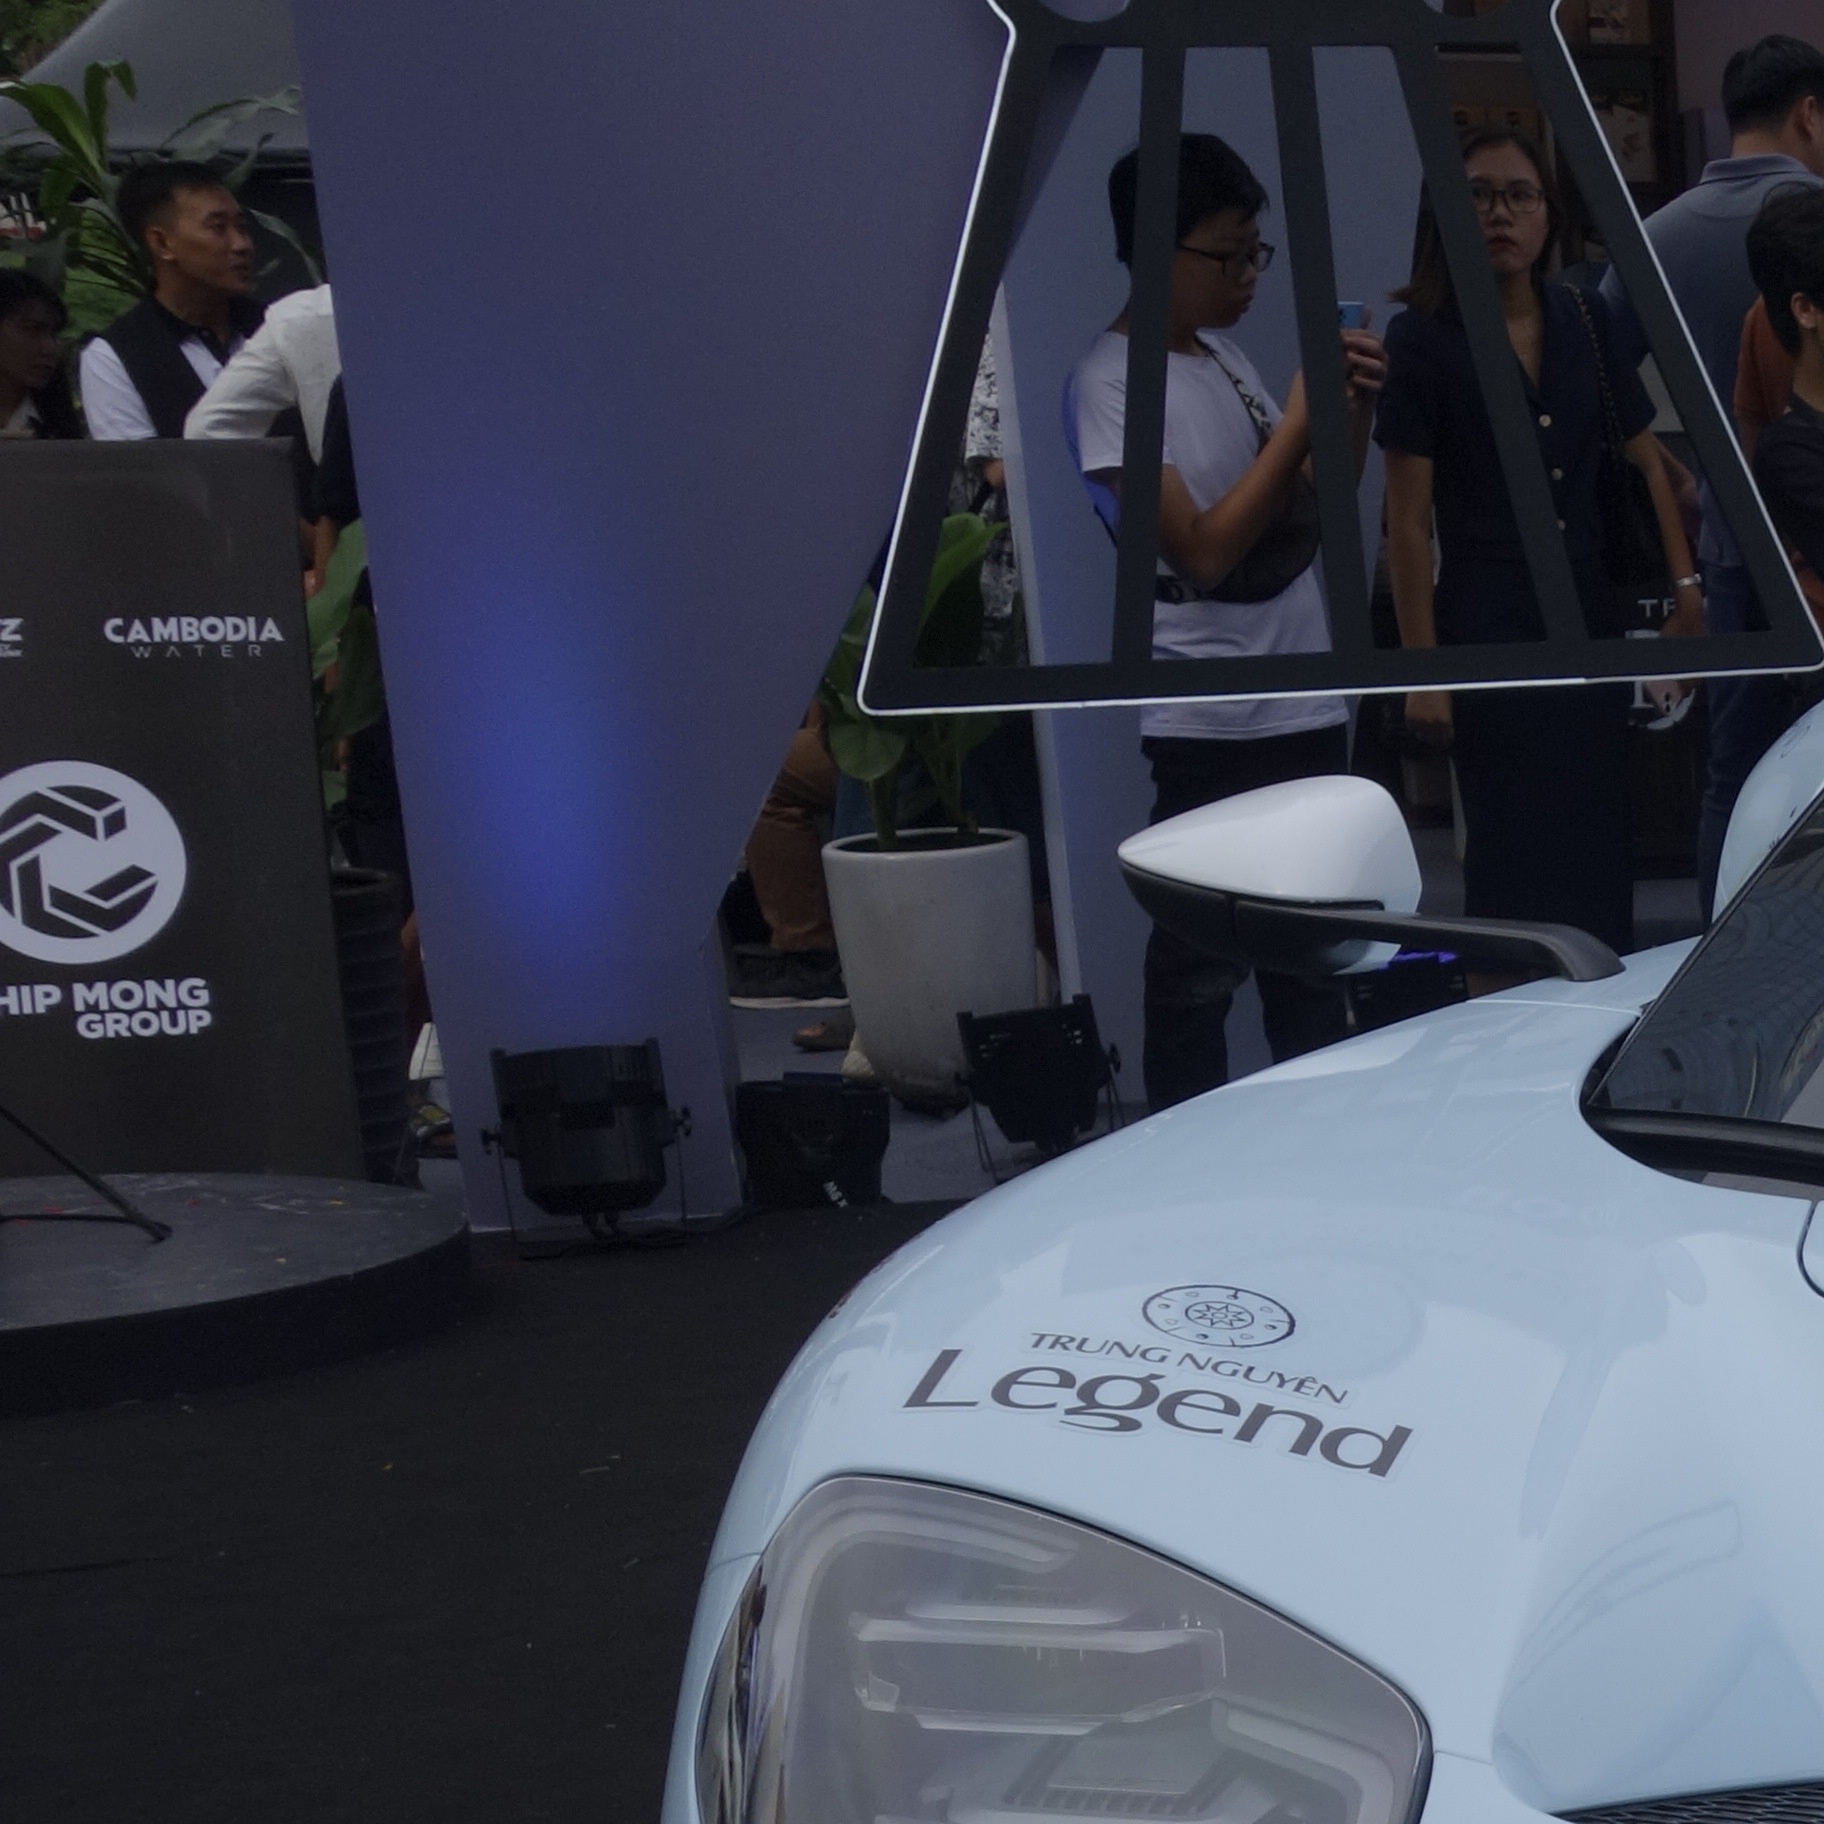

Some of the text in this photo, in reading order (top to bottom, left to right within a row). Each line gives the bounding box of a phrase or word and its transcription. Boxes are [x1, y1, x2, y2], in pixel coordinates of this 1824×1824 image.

[103, 615, 286, 644] CAMBODIA
[130, 644, 262, 658] WATER
[71, 977, 211, 1013] MONG
[75, 1008, 213, 1040] GROUP
[1029, 1332, 1349, 1405] TRUNG NGUYÊN
[901, 1348, 1415, 1478] Legend
